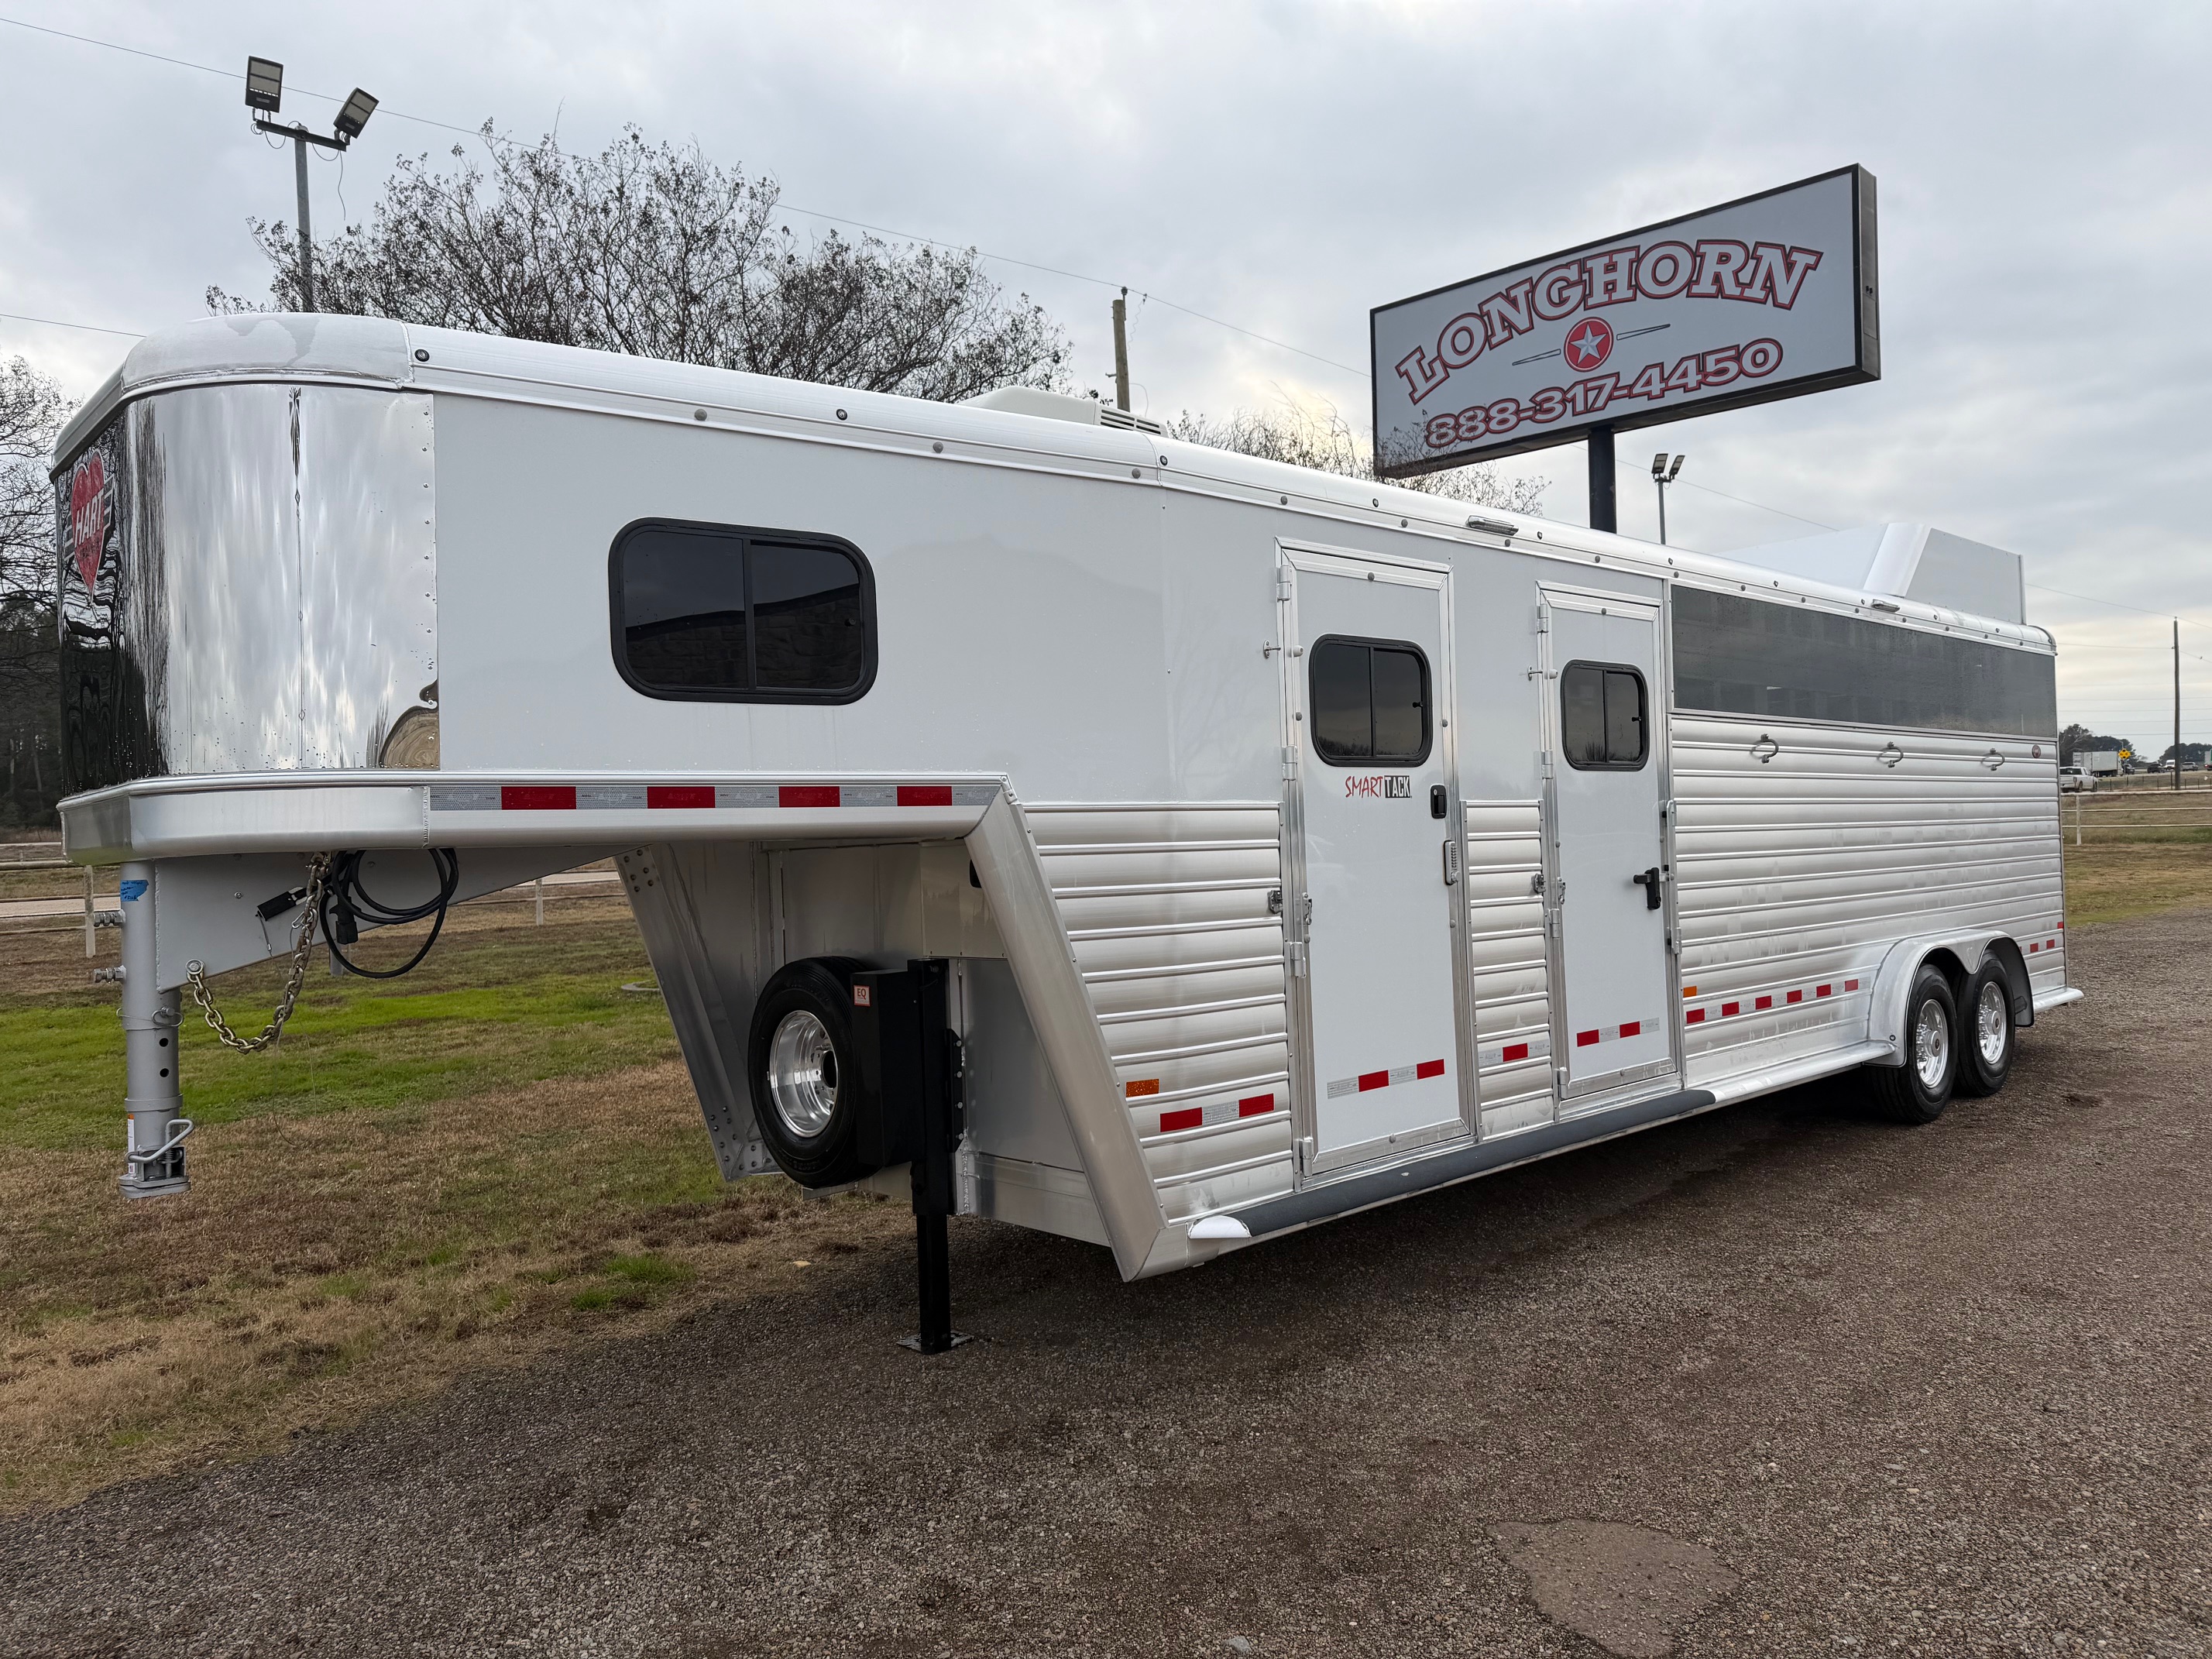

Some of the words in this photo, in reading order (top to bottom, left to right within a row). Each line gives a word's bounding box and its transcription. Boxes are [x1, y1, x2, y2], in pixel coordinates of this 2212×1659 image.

[1396, 239, 1823, 404] LONGHORN
[1426, 338, 1783, 448] 888-317-4450
[74, 487, 105, 548] HART
[1345, 775, 1383, 799] SMART
[1384, 776, 1411, 799] TACK
[857, 988, 867, 1000] EQ
